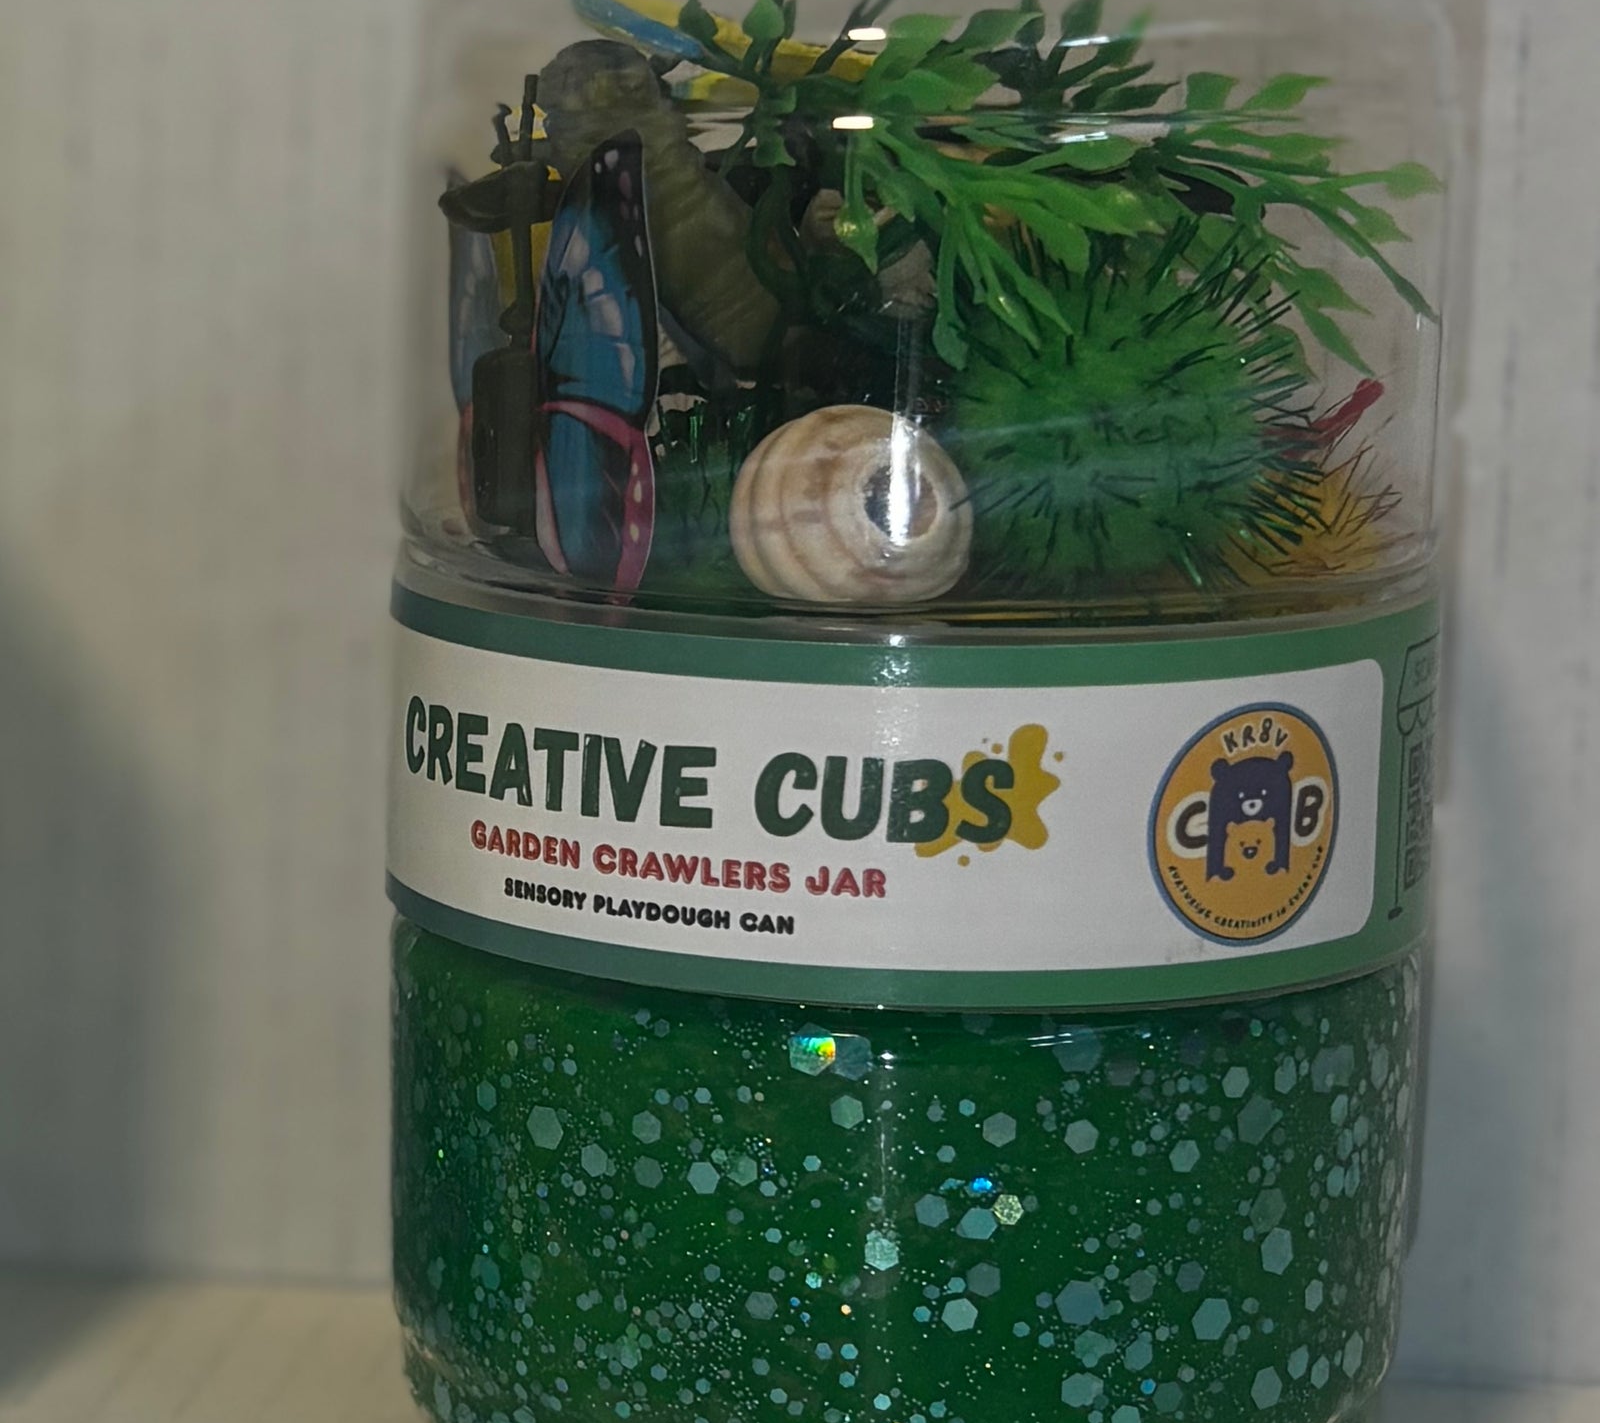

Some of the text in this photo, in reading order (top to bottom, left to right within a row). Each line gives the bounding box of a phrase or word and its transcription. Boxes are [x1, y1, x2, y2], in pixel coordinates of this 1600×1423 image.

[1223, 717, 1288, 753] KR8V
[405, 695, 1016, 844] CREATIVE CUBS
[470, 820, 887, 898] GARDEN CRAWLERS JAR
[503, 877, 795, 935] SENSORY PLAYDOUGH CAN
